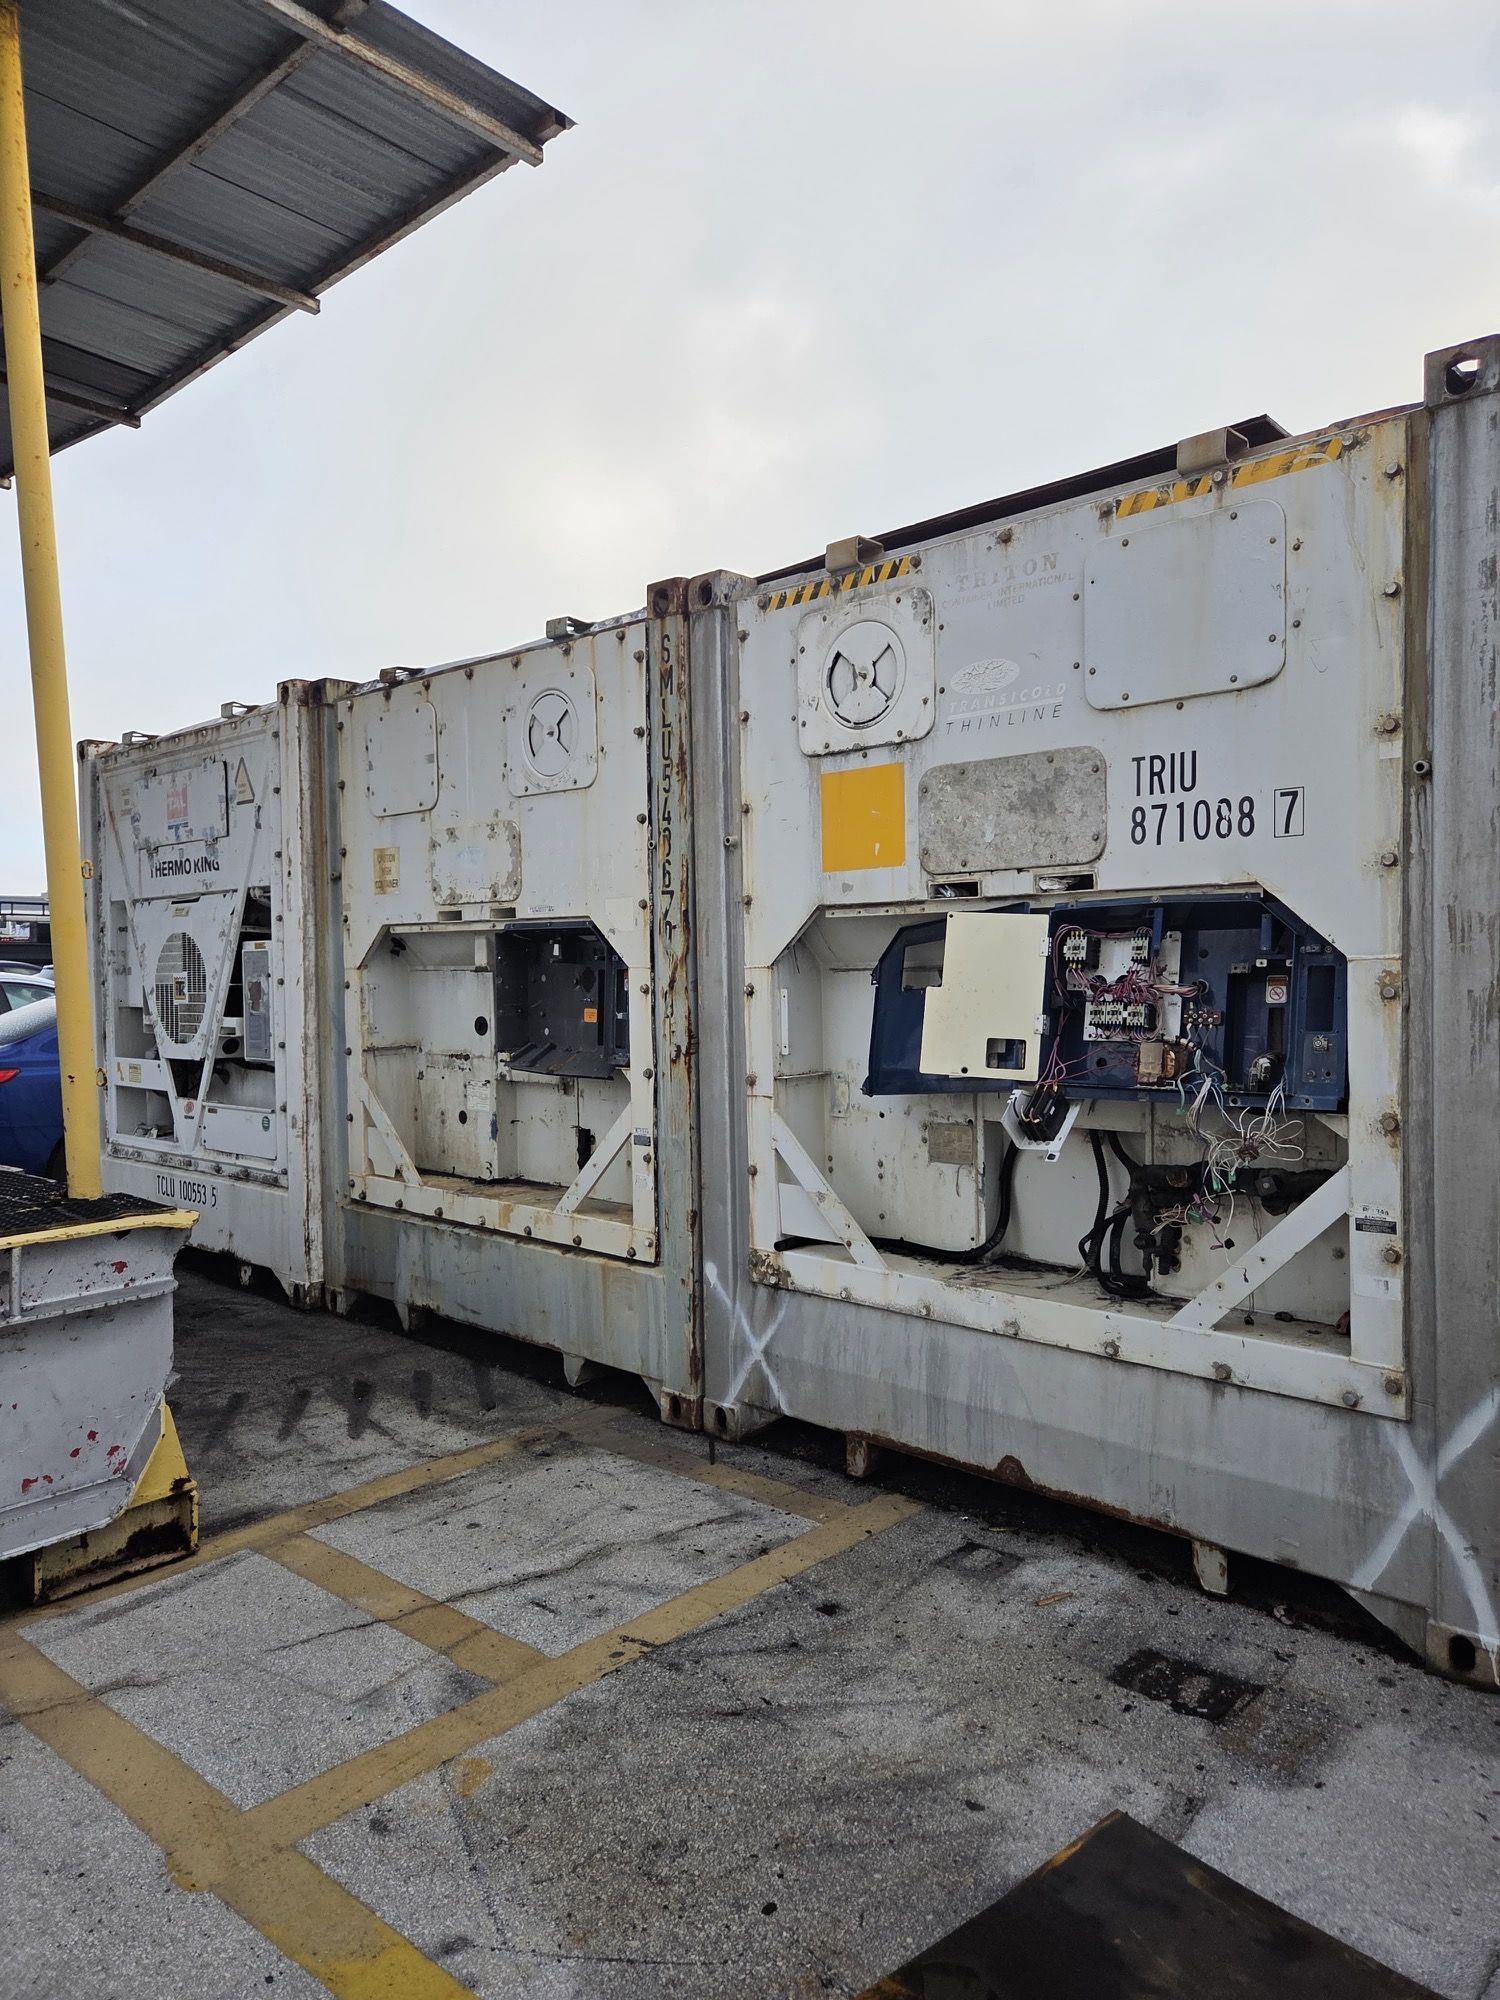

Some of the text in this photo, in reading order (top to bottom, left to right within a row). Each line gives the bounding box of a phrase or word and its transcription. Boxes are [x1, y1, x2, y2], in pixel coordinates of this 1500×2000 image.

[946, 704, 1063, 735] THINLINE
[1131, 750, 1197, 797] TRIU
[1130, 790, 1299, 846] 871088 7
[193, 856, 220, 873] KING
[157, 1175, 217, 1208] TCLU 100553 5
